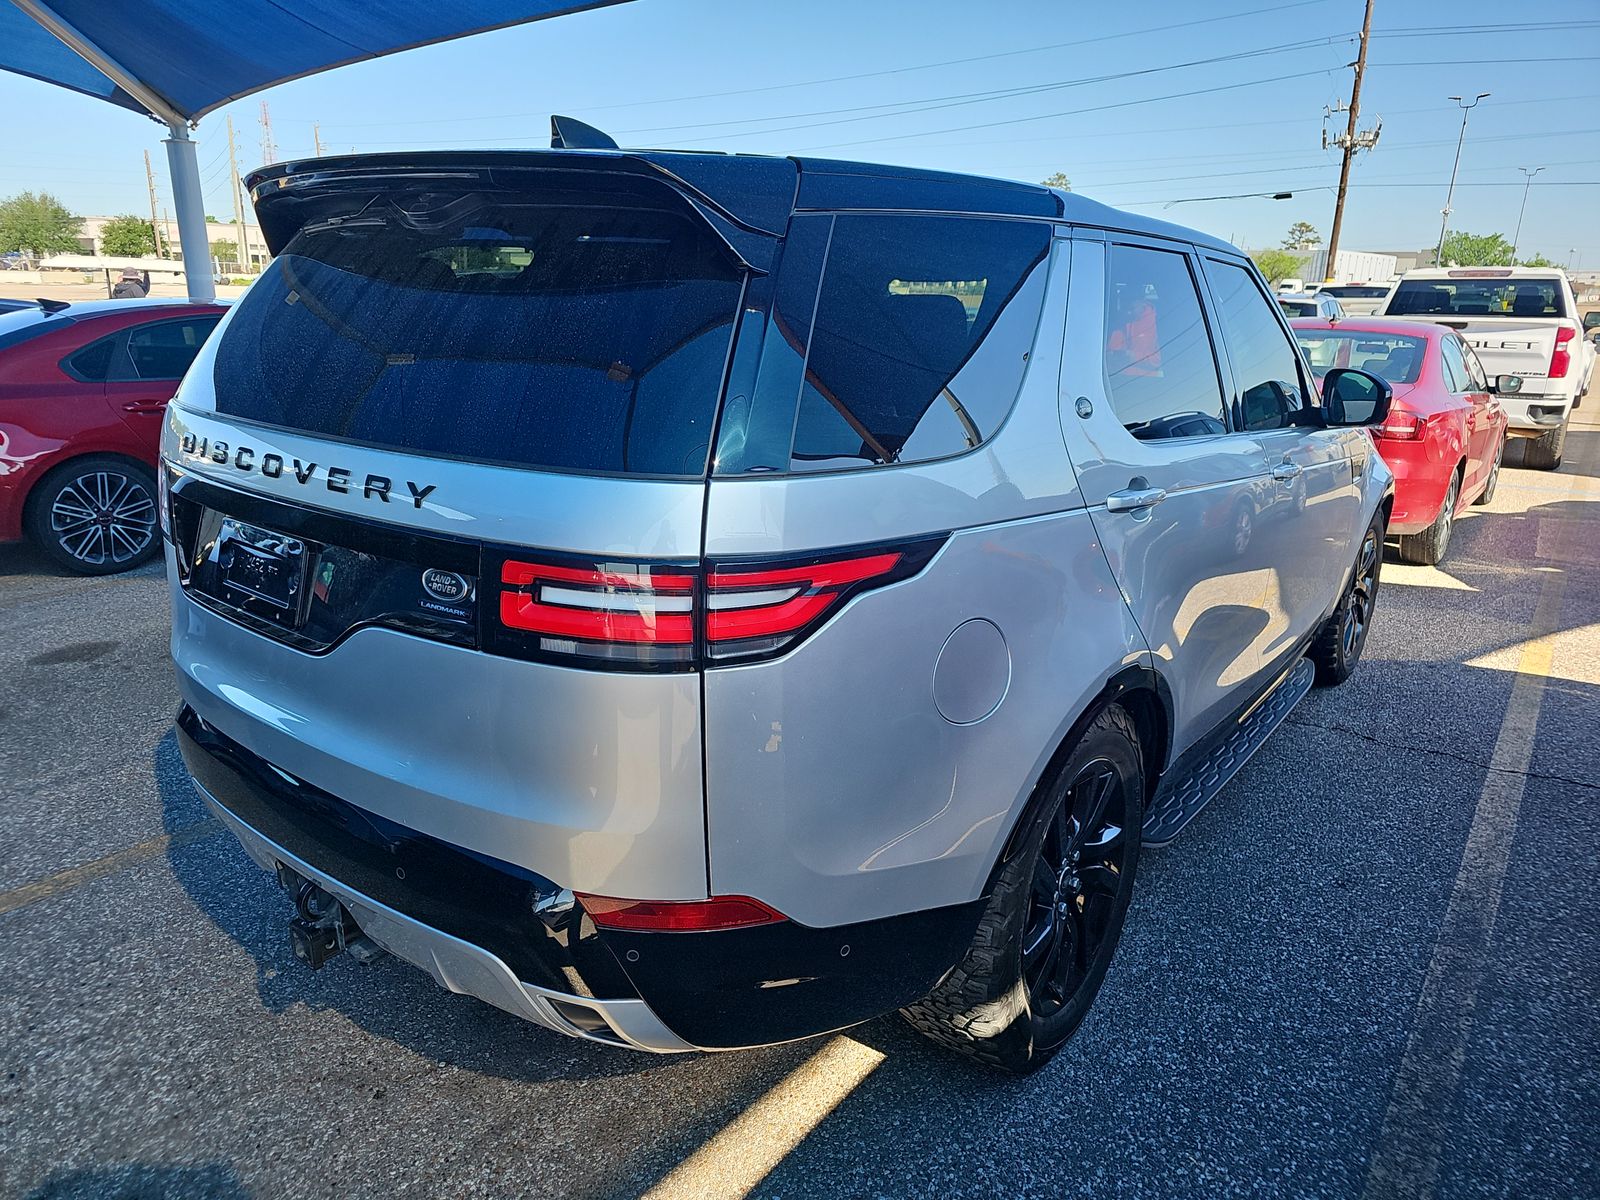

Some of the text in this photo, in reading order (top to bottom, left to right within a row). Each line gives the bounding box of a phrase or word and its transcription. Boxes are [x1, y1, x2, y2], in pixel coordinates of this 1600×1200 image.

[182, 432, 437, 509] DISCOVERY
[430, 573, 452, 585] LAND
[432, 583, 457, 595] ROVER
[420, 601, 466, 617] LANDMARK
